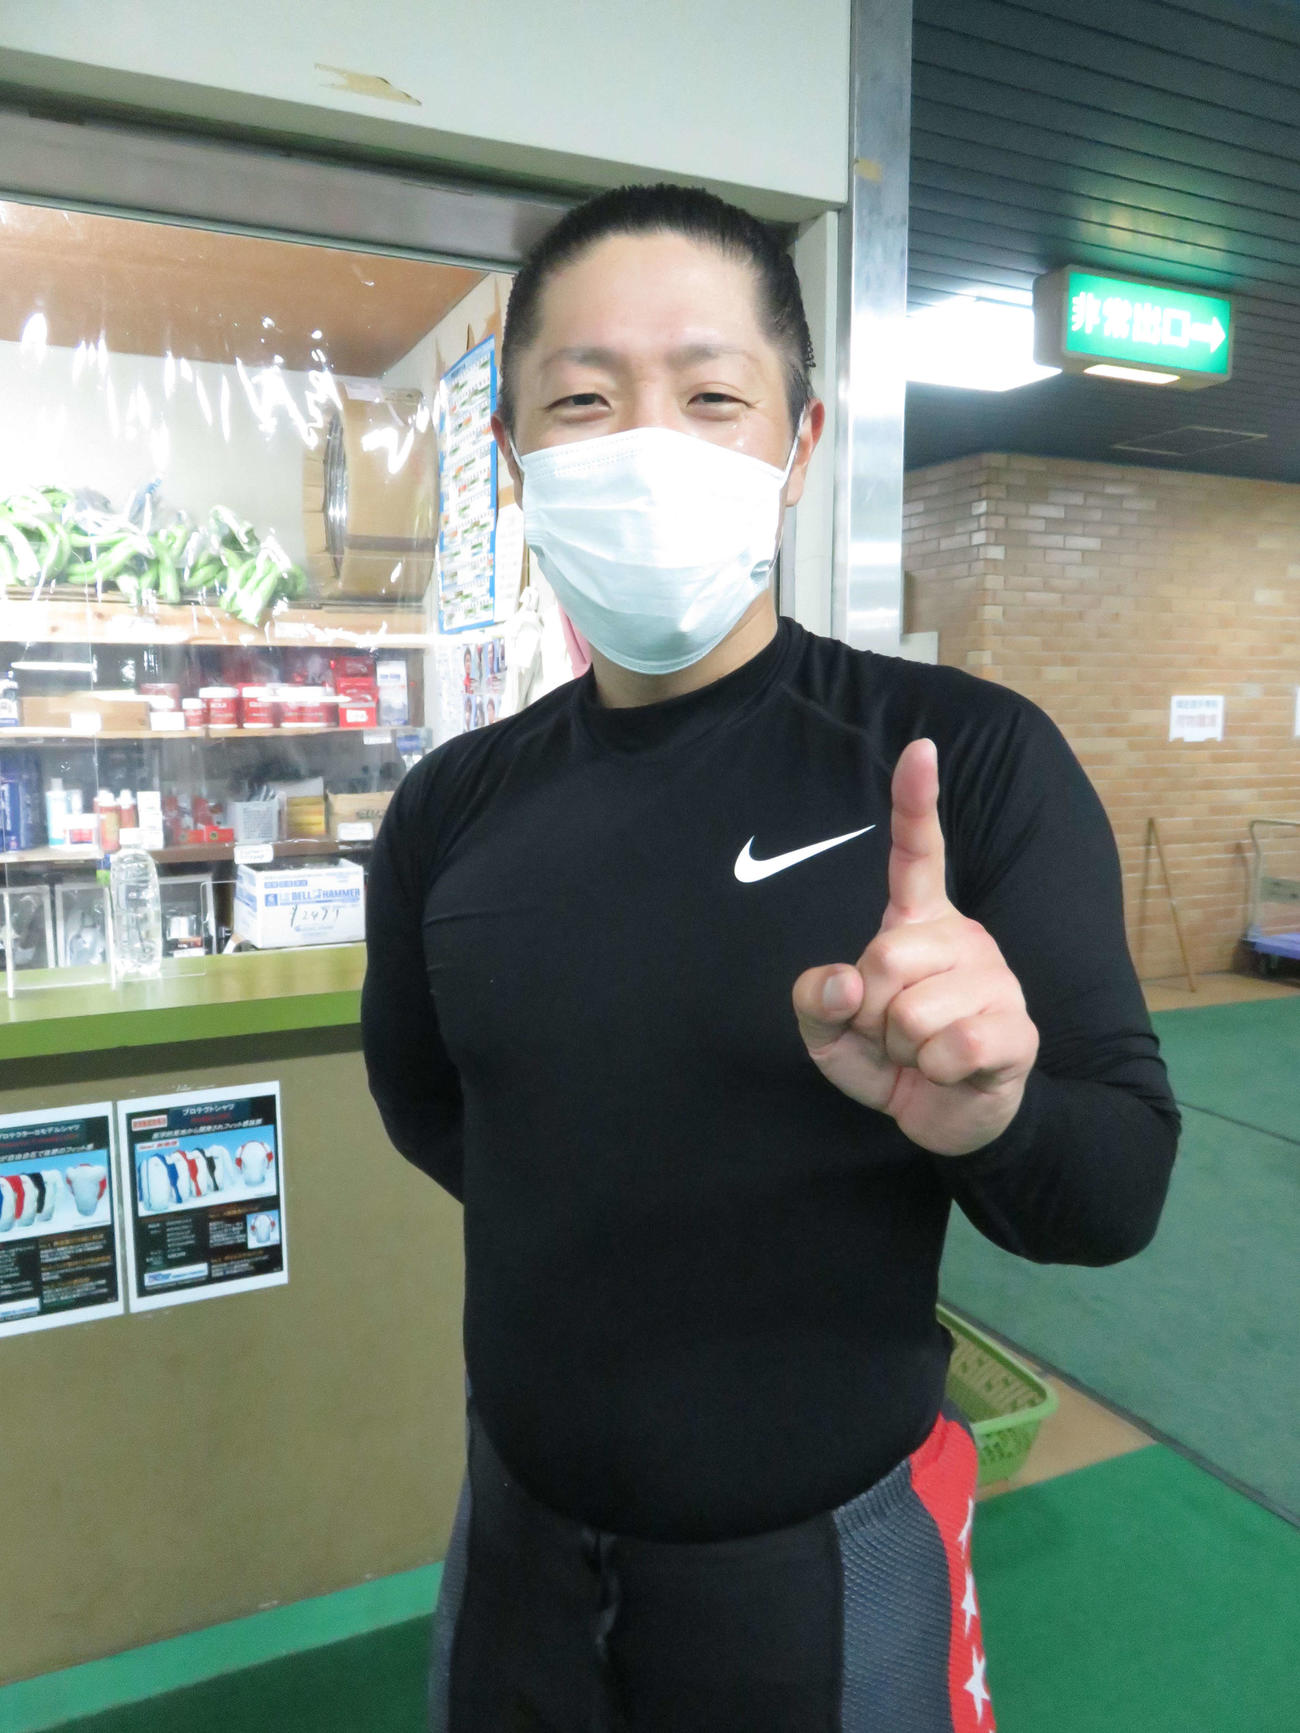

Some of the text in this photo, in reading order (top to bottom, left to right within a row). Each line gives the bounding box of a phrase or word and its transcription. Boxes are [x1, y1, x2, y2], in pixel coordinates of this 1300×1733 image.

[1071, 291, 1190, 349] 非常出口
[292, 889, 312, 901] BELL
[322, 887, 360, 899] HAMMER
